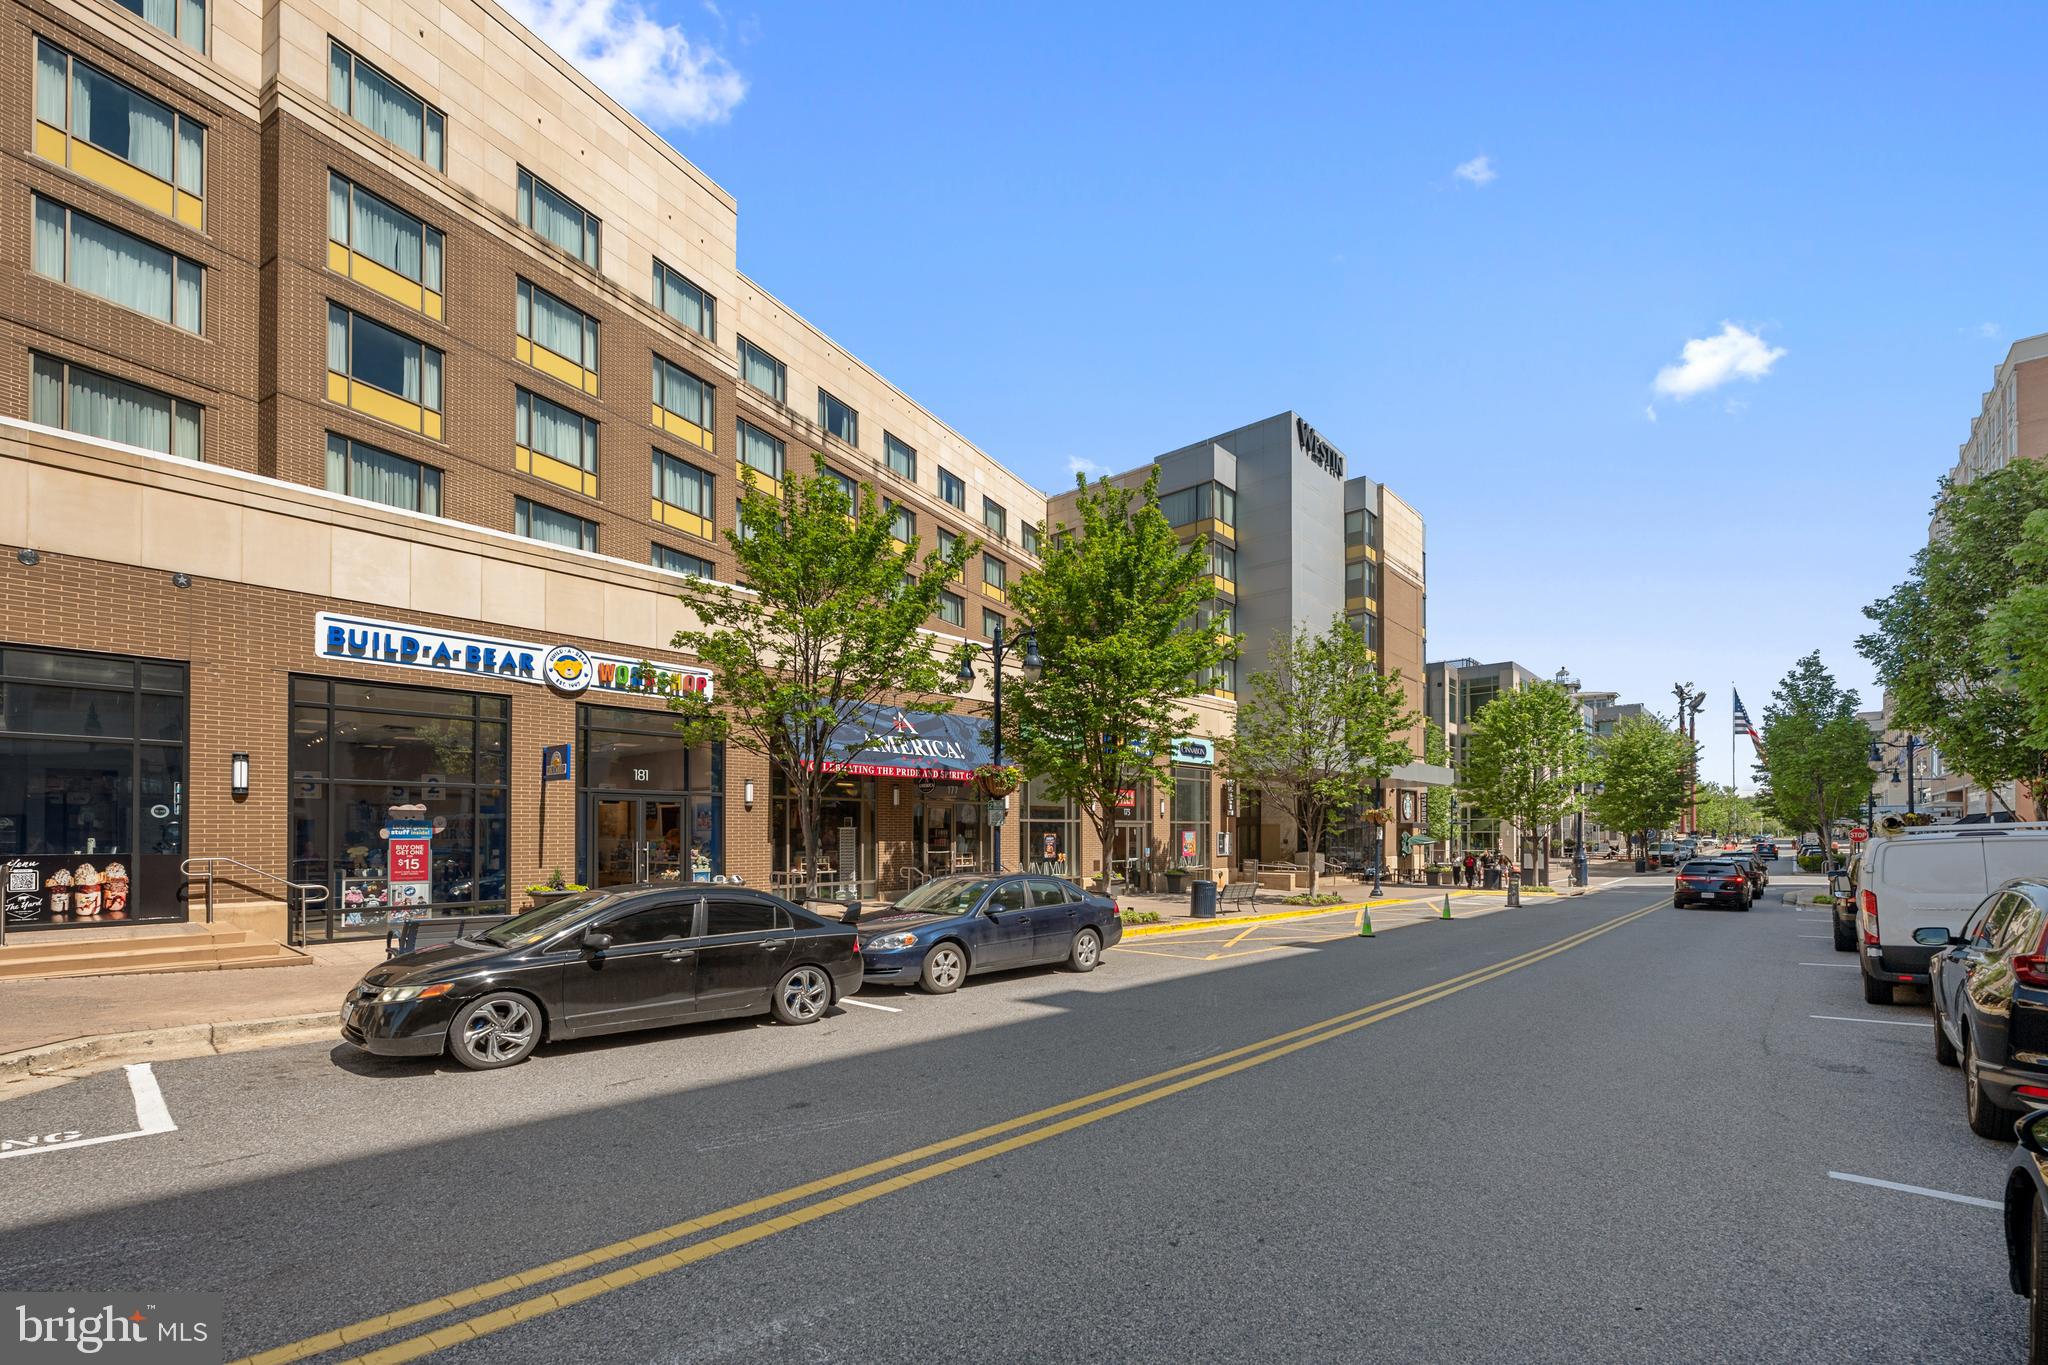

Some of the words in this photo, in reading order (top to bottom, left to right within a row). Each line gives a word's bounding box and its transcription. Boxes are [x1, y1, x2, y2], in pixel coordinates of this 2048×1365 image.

[1296, 417, 1343, 477] WESTIN
[633, 769, 649, 781] 181
[877, 766, 894, 775] THE
[896, 767, 921, 777] PRIDE
[922, 769, 939, 778] AND
[940, 770, 965, 780] SPIRIT
[398, 858, 420, 870] $15
